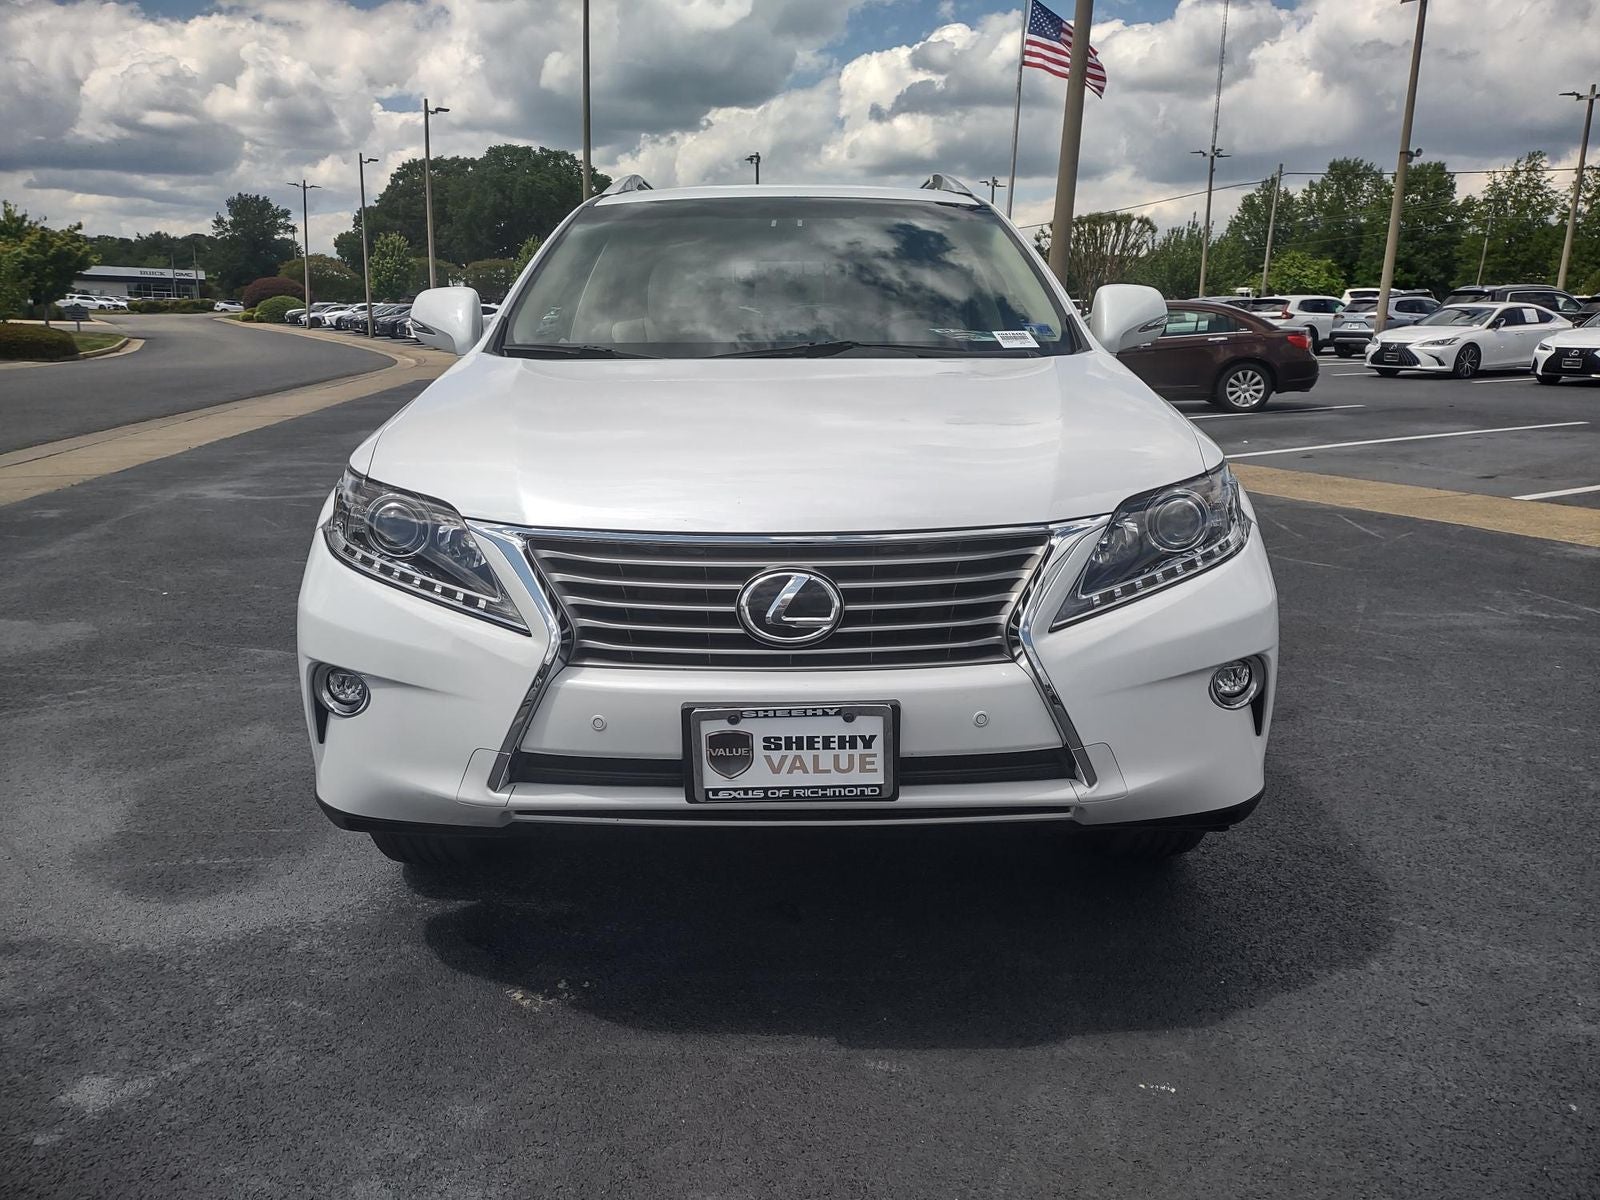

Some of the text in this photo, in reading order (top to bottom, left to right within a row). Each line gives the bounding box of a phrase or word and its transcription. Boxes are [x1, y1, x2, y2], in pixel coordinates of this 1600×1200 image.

[741, 708, 841, 718] SHEEHY
[762, 734, 878, 751] SHEEHY
[708, 747, 750, 757] VALUE
[763, 753, 878, 775] VALUE
[708, 786, 880, 799] LEXUS OF RICHMOND
